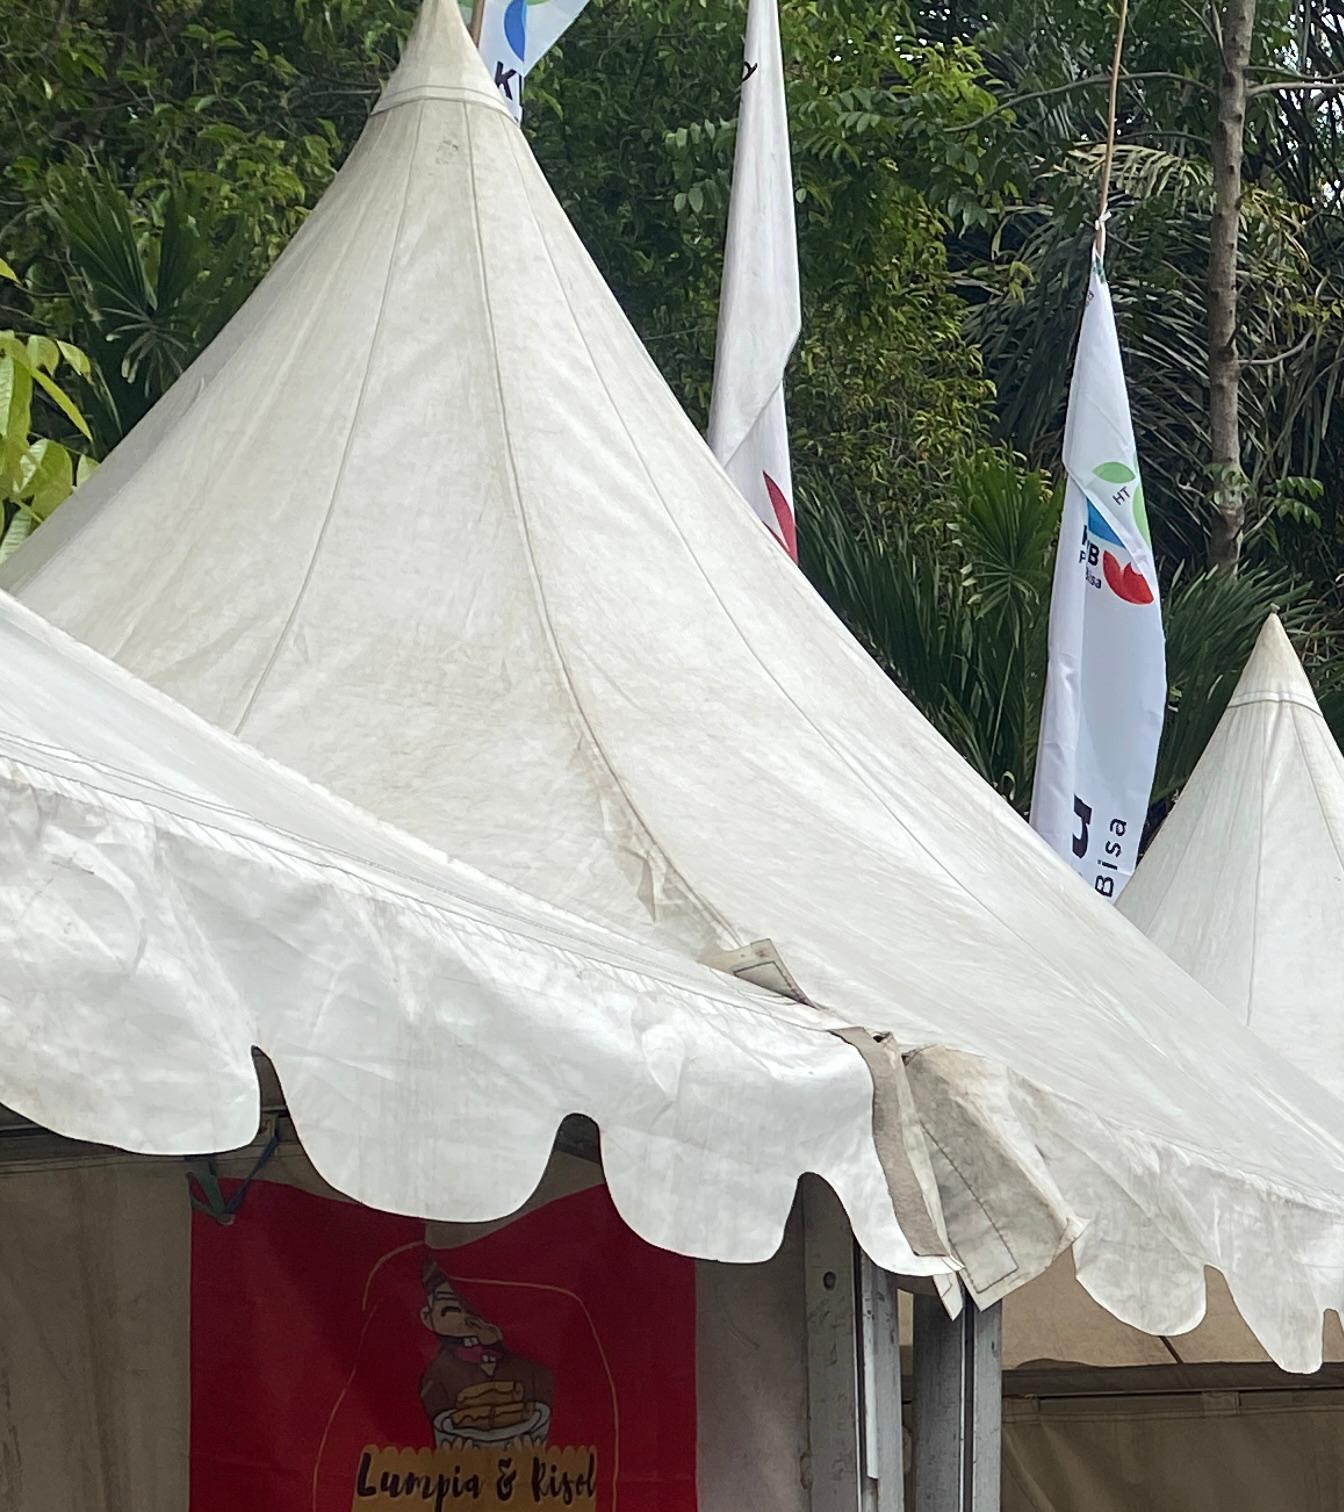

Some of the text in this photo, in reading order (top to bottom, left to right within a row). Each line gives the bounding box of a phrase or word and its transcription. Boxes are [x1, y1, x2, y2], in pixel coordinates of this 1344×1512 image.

[1095, 818, 1127, 898] Bisa
[496, 1456, 517, 1501] &
[531, 1452, 596, 1505] Risol
